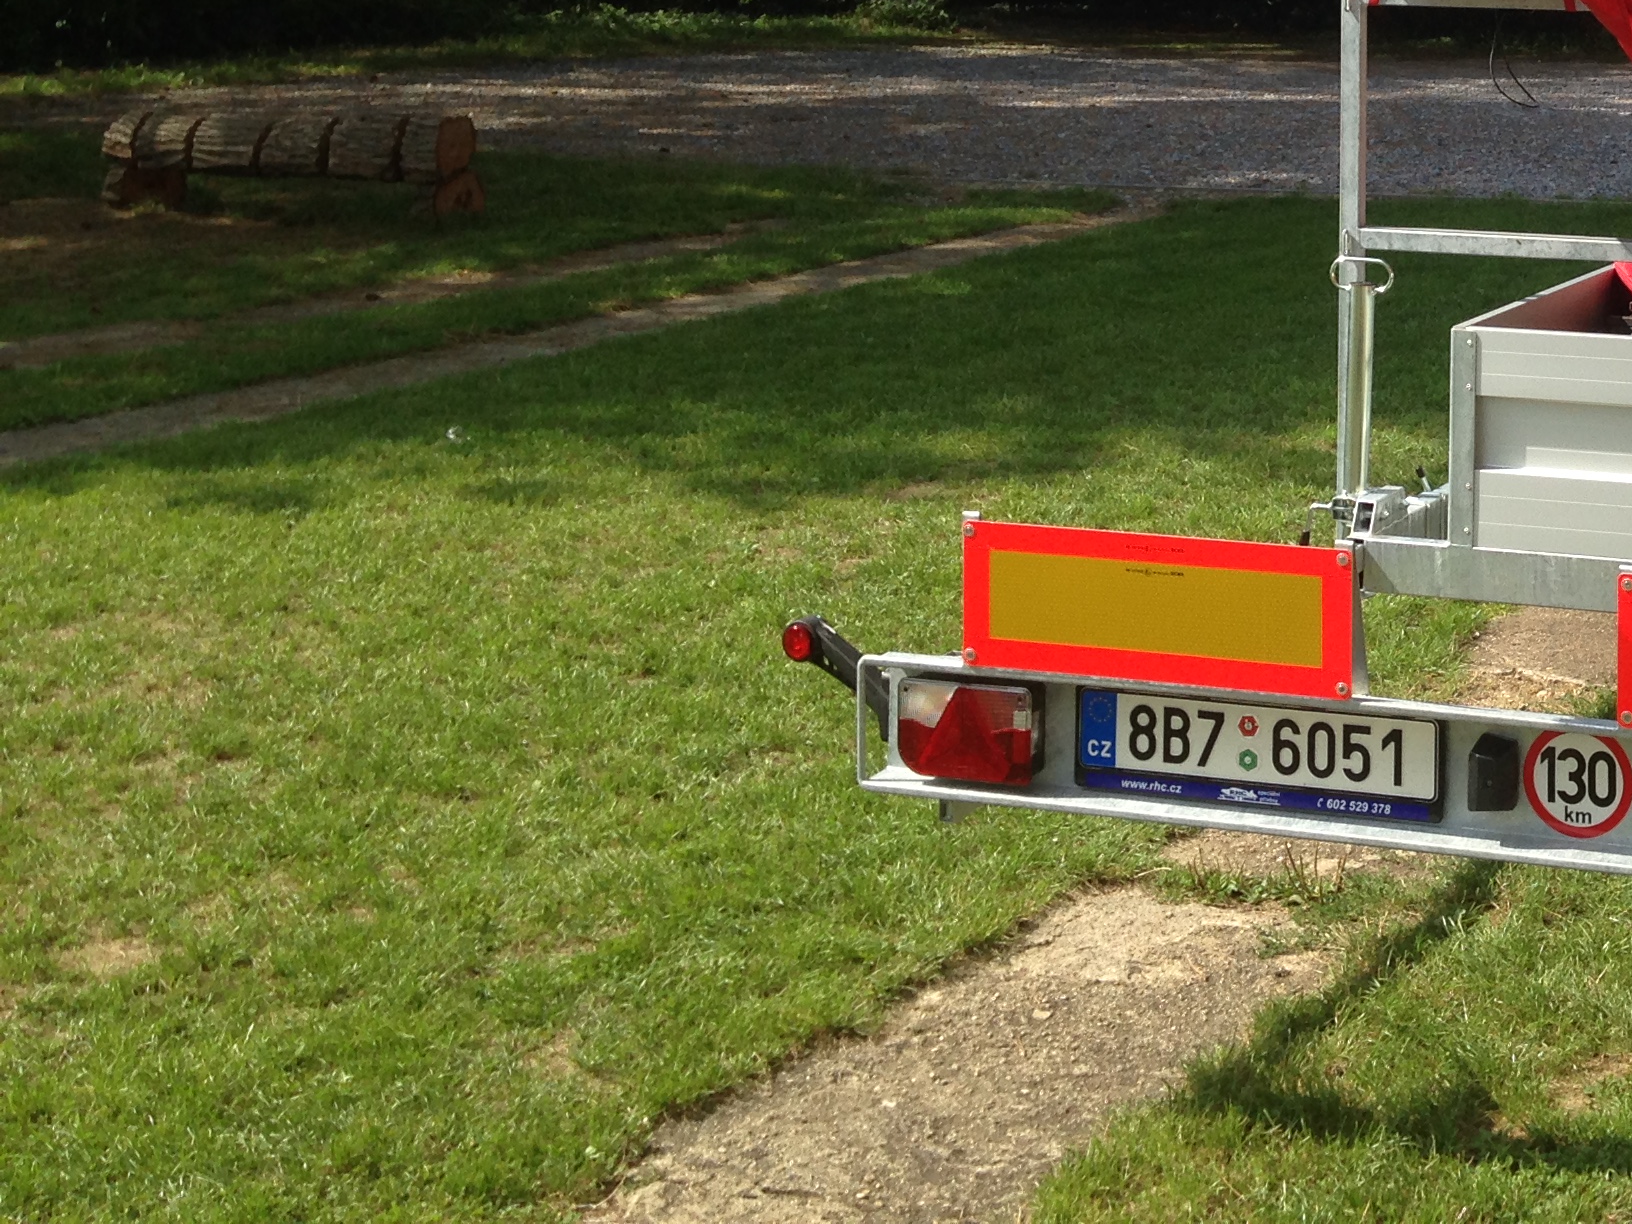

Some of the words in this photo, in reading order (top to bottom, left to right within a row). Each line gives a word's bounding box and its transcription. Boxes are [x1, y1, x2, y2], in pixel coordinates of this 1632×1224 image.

[1087, 739, 1112, 758] CZ
[1128, 704, 1226, 768] 8B7
[1272, 718, 1403, 787] 6051
[1121, 778, 1183, 794] www.rhc.cz
[1540, 745, 1617, 808] 130
[1326, 797, 1347, 811] 602
[1349, 800, 1369, 813] 529
[1371, 802, 1392, 816] 378
[1564, 805, 1592, 825] km
